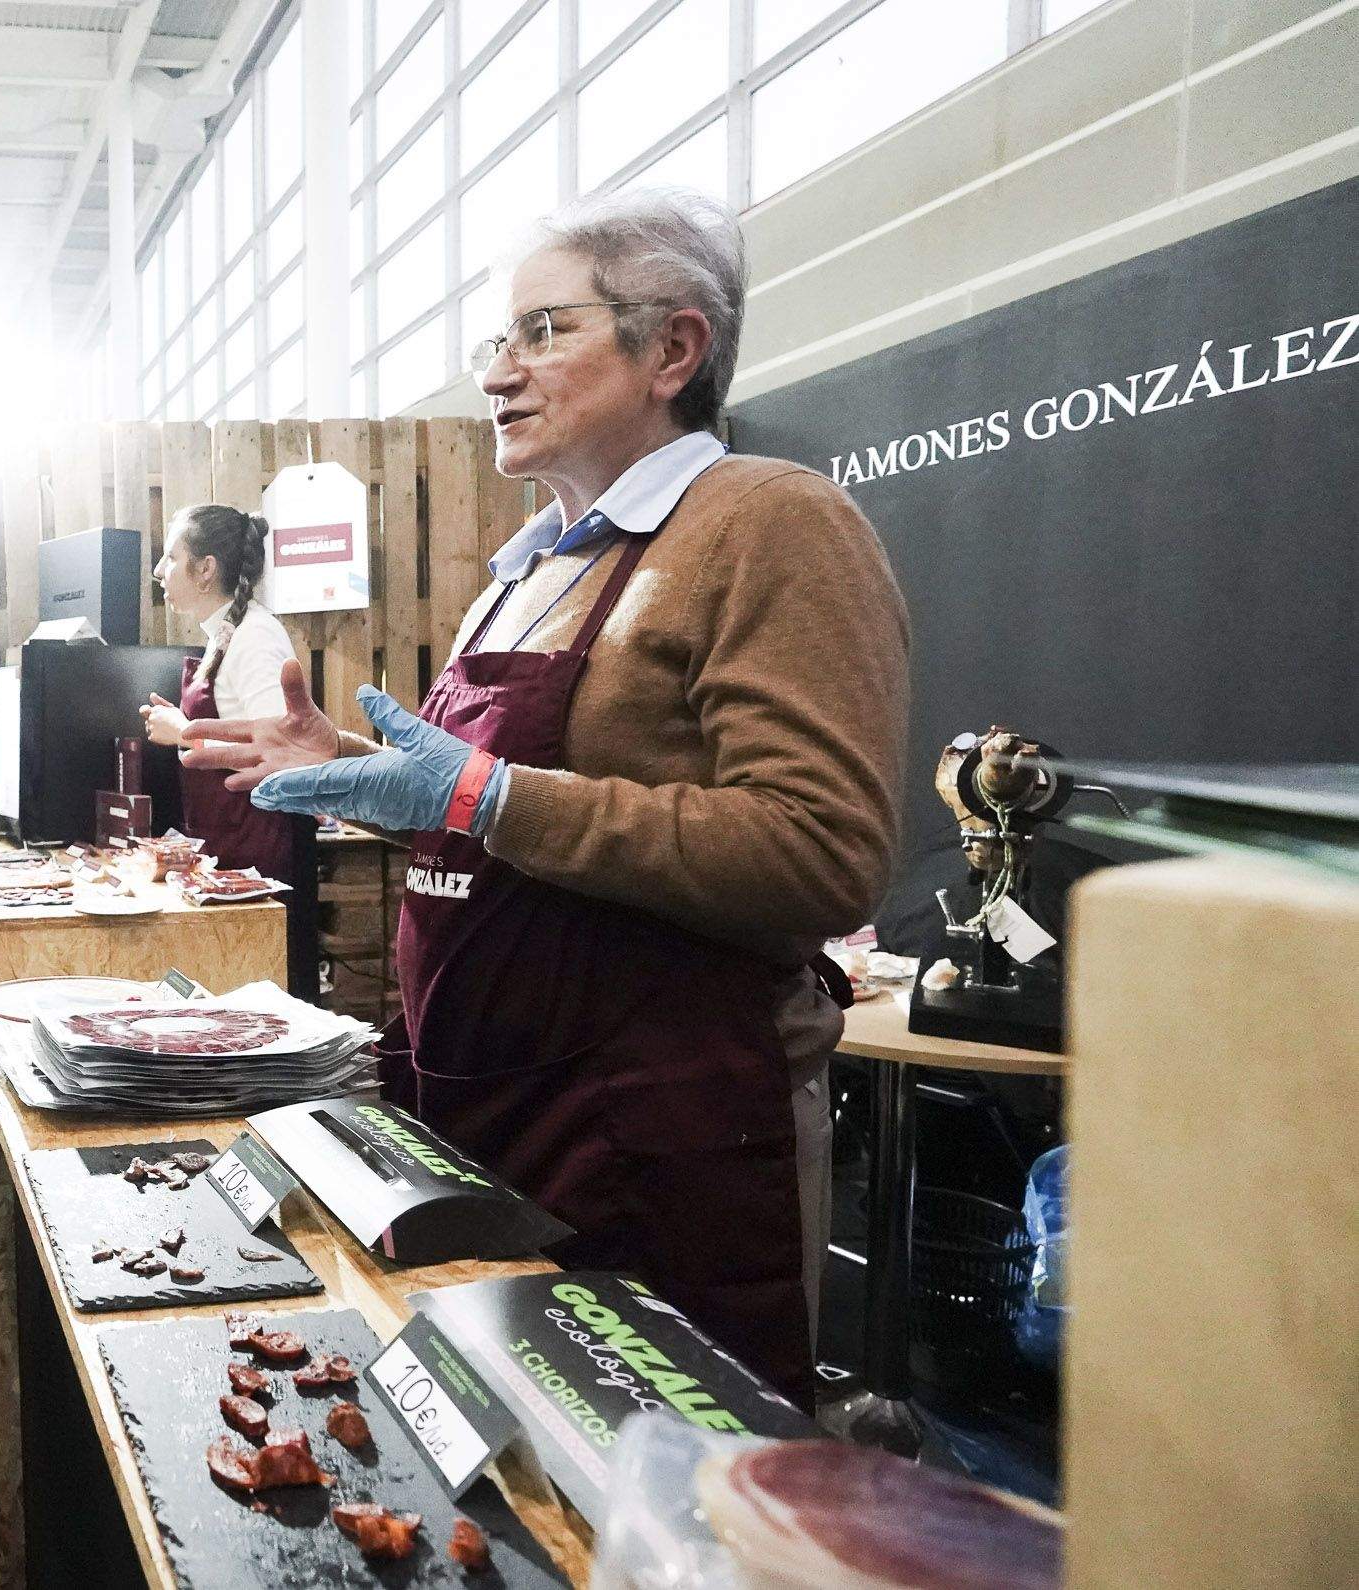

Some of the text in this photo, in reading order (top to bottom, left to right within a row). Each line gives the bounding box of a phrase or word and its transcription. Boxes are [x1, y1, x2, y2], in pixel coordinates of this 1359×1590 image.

[830, 314, 1359, 487] JAMONES GONZÁLEZ
[508, 1338, 532, 1353] 3
[522, 1352, 619, 1448] CHORIZOS
[551, 1283, 750, 1438] GONZÁLE
